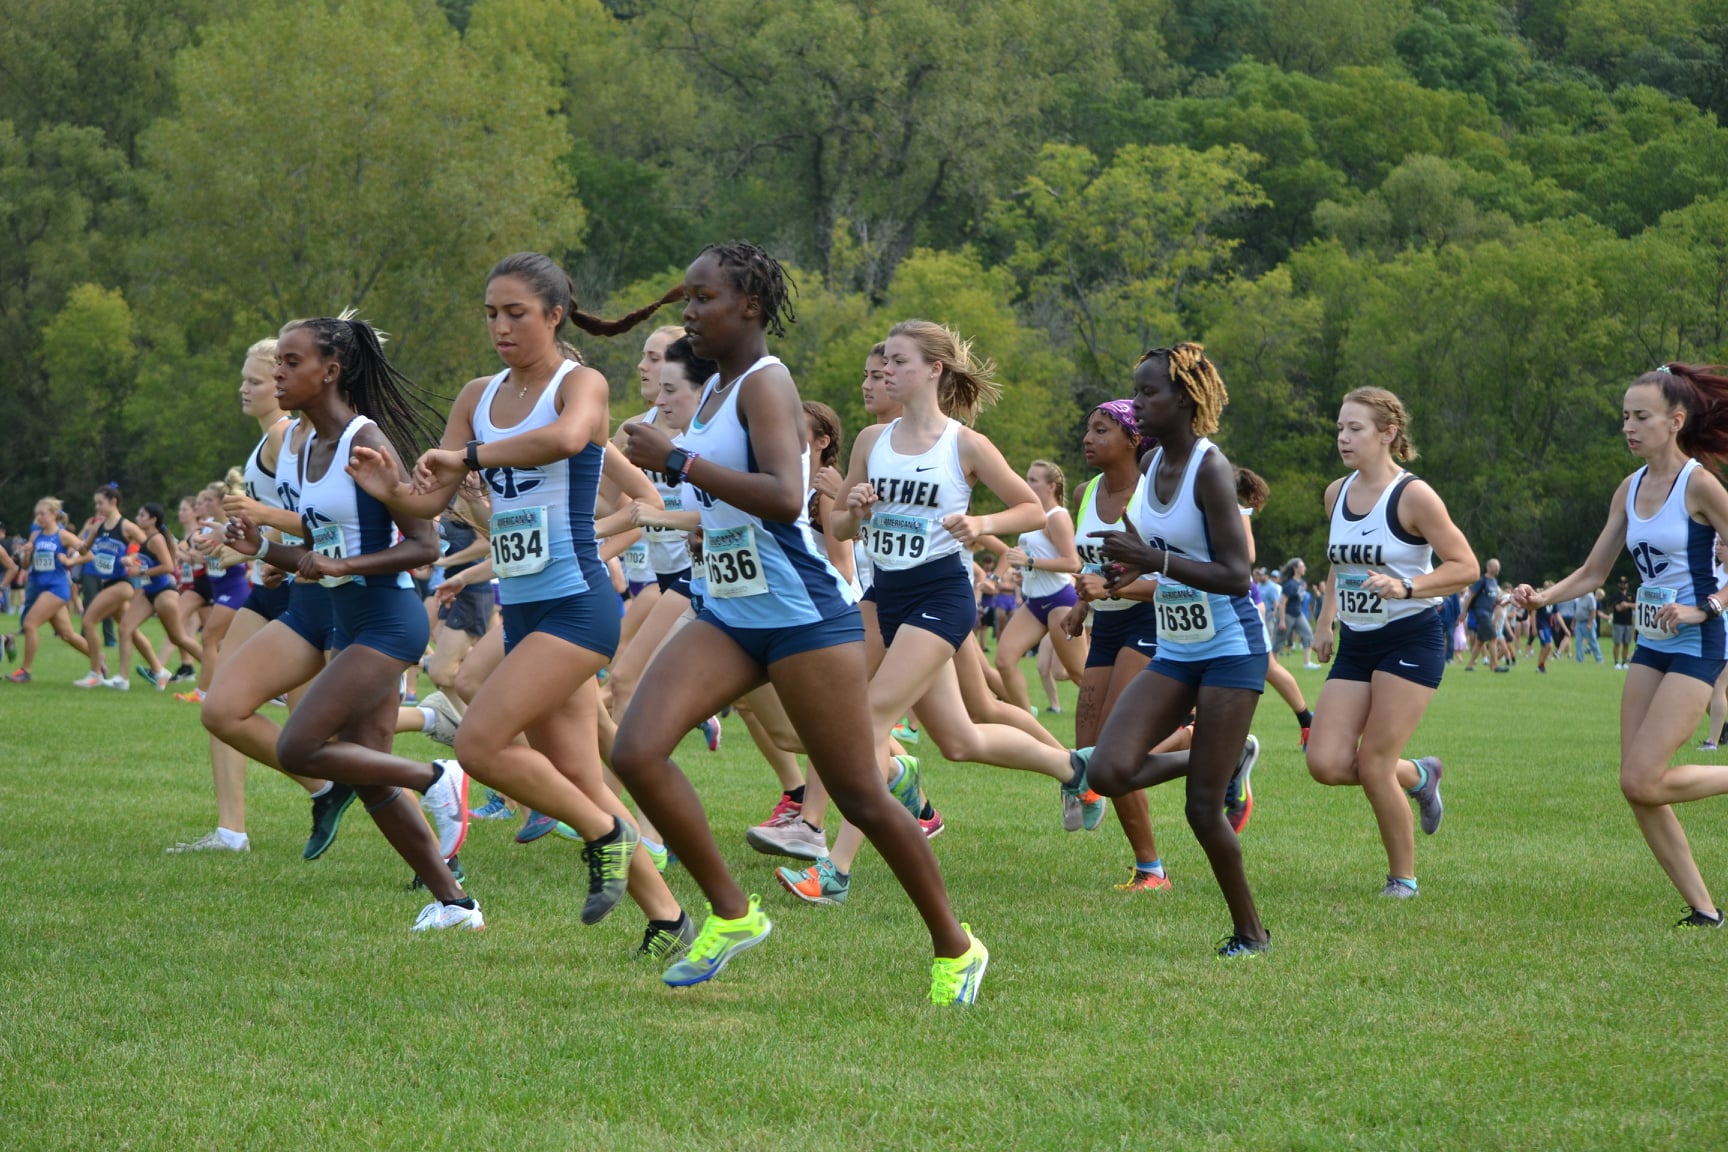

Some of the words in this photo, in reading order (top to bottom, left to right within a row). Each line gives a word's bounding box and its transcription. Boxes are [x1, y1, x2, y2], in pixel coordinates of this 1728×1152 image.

[491, 529, 543, 565] 1634
[625, 551, 646, 564] 1702
[872, 530, 925, 558] 1519
[1329, 544, 1386, 566] ETHEL
[705, 549, 757, 585] 1636
[1338, 590, 1383, 614] 1522
[1637, 602, 1662, 630] 163
[1157, 603, 1208, 632] 1638
